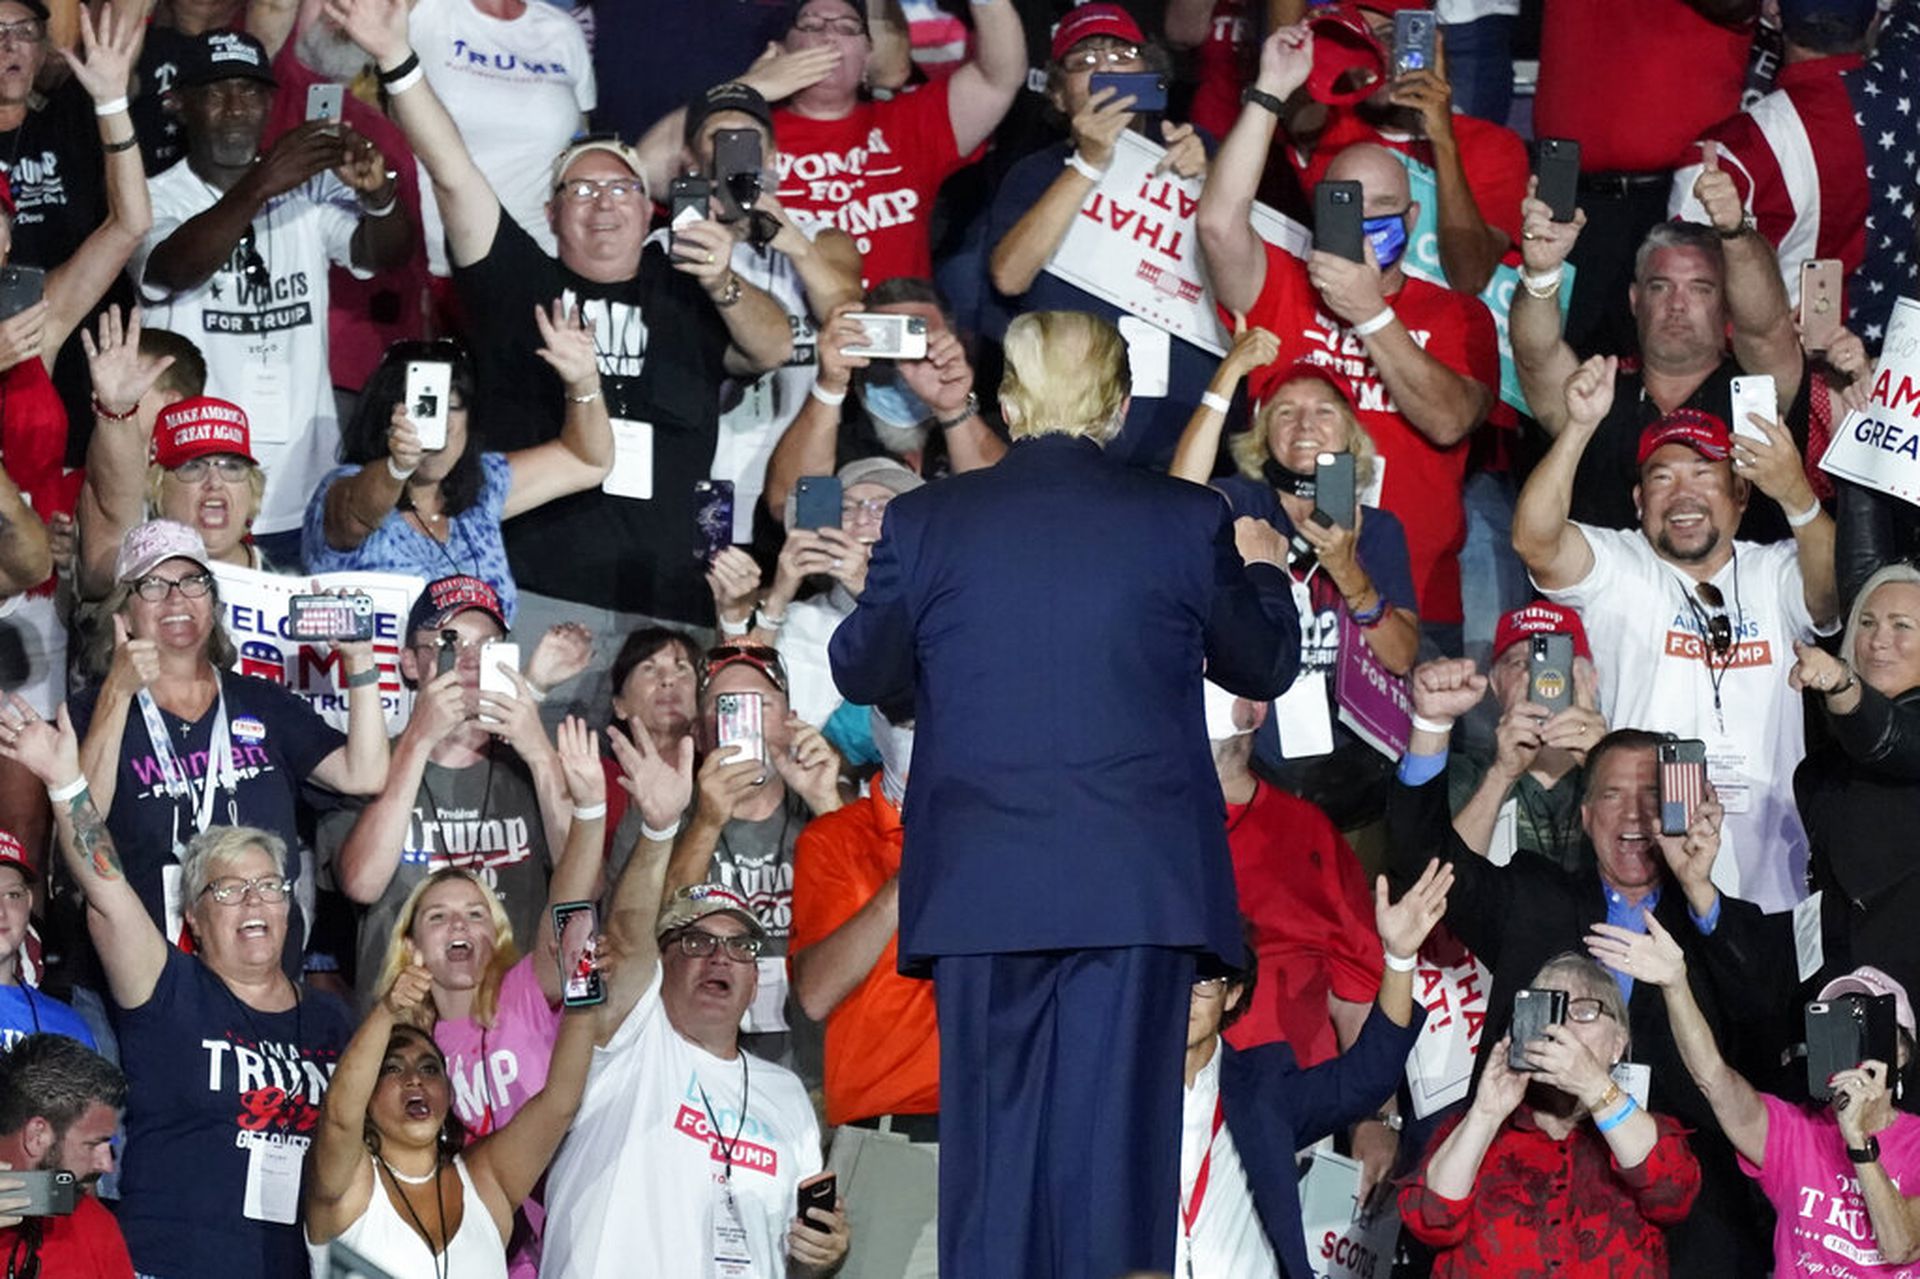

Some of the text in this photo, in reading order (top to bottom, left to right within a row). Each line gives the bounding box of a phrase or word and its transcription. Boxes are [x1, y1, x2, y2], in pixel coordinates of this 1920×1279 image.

[783, 188, 919, 242] RUMP
[1080, 192, 1182, 262] THAT
[205, 313, 243, 331] FOR
[164, 405, 246, 430] MAKE AMERICA
[174, 424, 244, 446] GREAT AGAIN
[1512, 608, 1564, 623] Trump
[1710, 646, 1764, 666] RUMP
[1361, 658, 1388, 695] FOR
[1451, 952, 1487, 1055] THA
